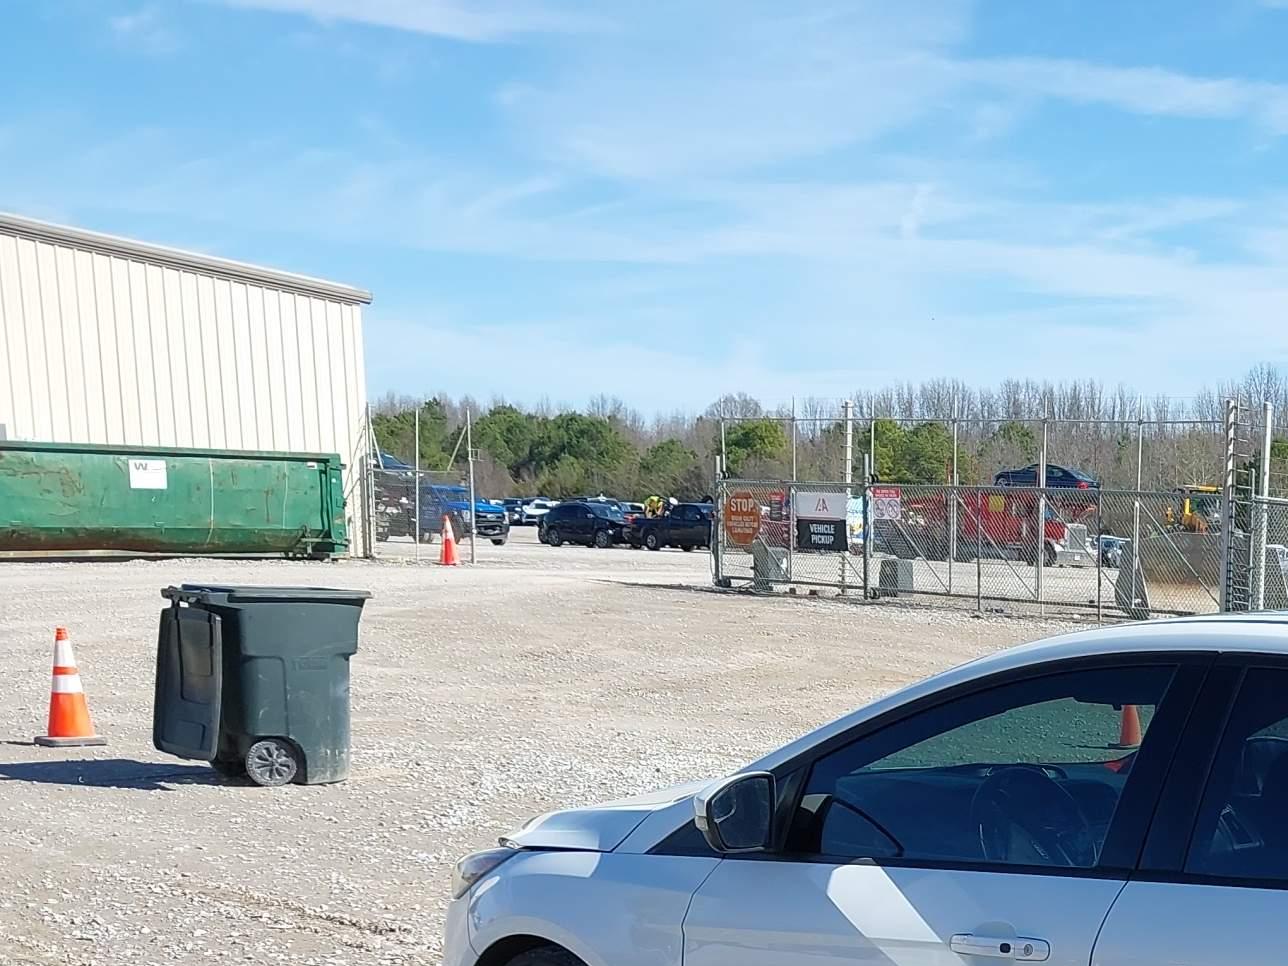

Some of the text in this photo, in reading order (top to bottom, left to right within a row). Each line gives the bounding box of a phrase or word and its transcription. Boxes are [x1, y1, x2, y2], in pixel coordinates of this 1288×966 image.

[730, 498, 754, 512] STOP
[809, 523, 835, 534] VEHICLE
[811, 534, 834, 545] PICKUP
